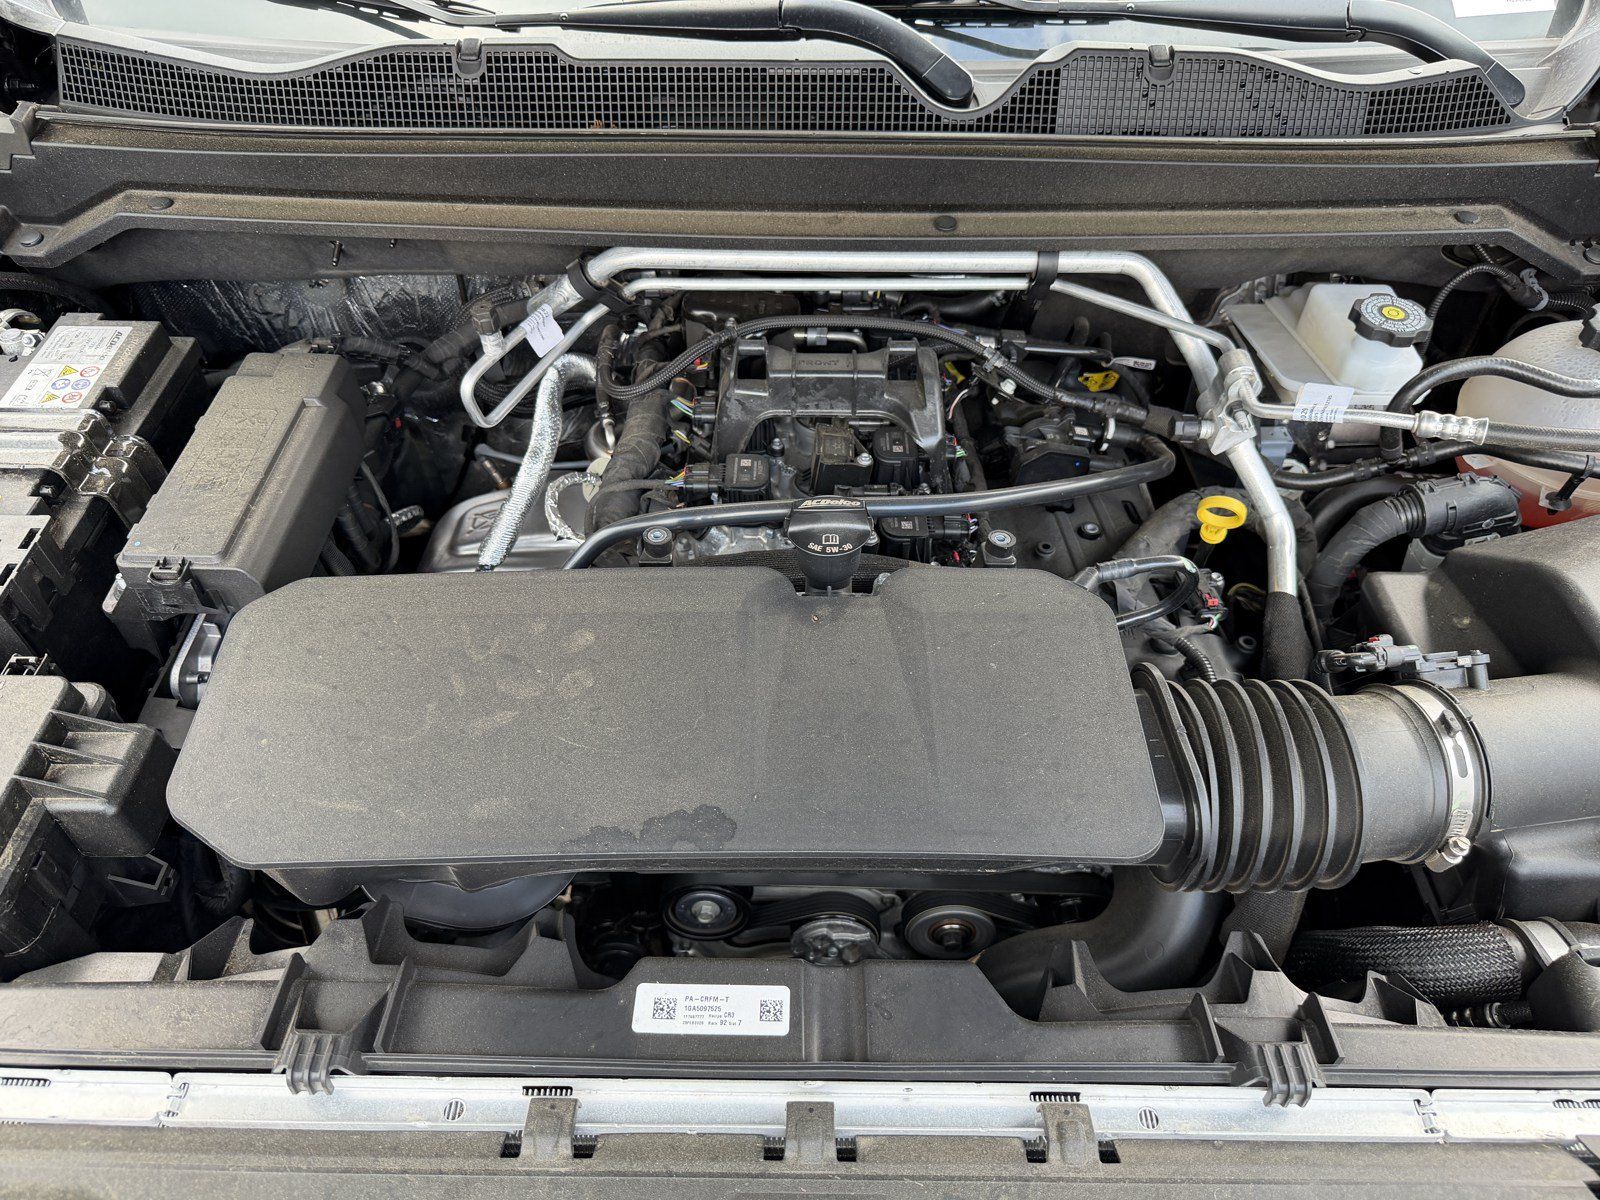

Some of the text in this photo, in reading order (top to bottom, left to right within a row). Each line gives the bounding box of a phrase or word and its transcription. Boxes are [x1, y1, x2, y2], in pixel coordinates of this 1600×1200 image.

[798, 499, 861, 509] ACDelco
[807, 542, 853, 554] SAE 5W-30
[684, 995, 730, 1003] PA-CRFM-T
